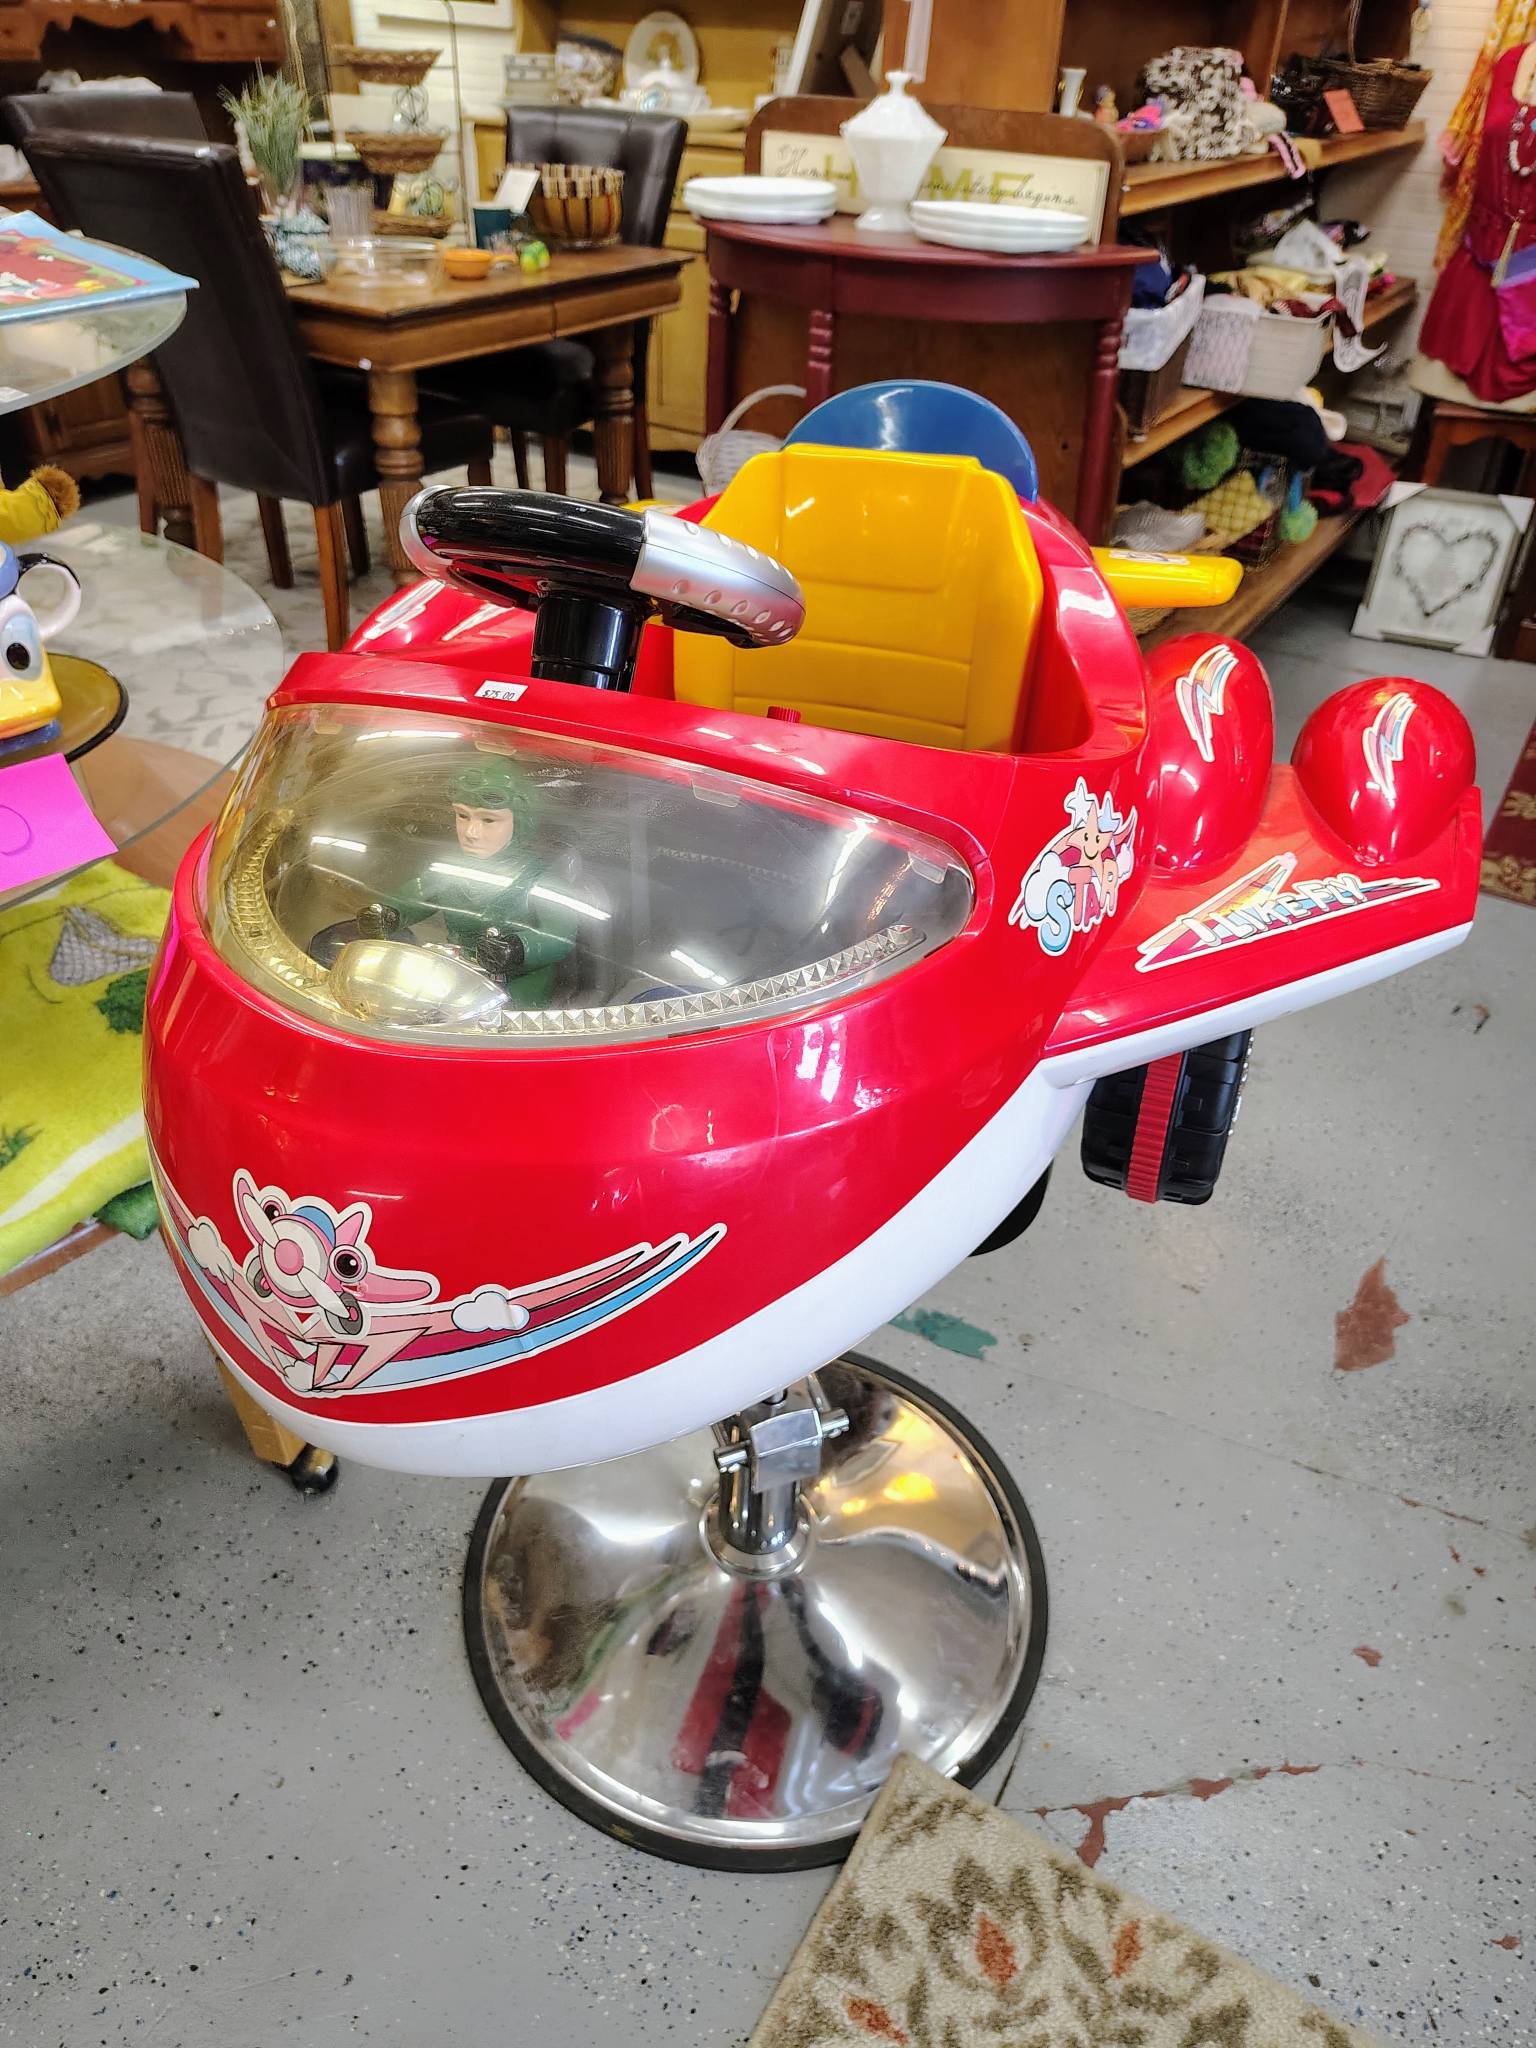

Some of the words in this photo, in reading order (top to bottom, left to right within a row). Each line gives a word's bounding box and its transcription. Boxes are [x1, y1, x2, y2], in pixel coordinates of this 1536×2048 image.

[824, 153, 1033, 204] HME
[482, 689, 516, 701] $7500
[1041, 858, 1119, 952] STAR
[1180, 917, 1222, 947] I
[1207, 895, 1313, 940] LIKE
[1296, 875, 1369, 913] FLY
